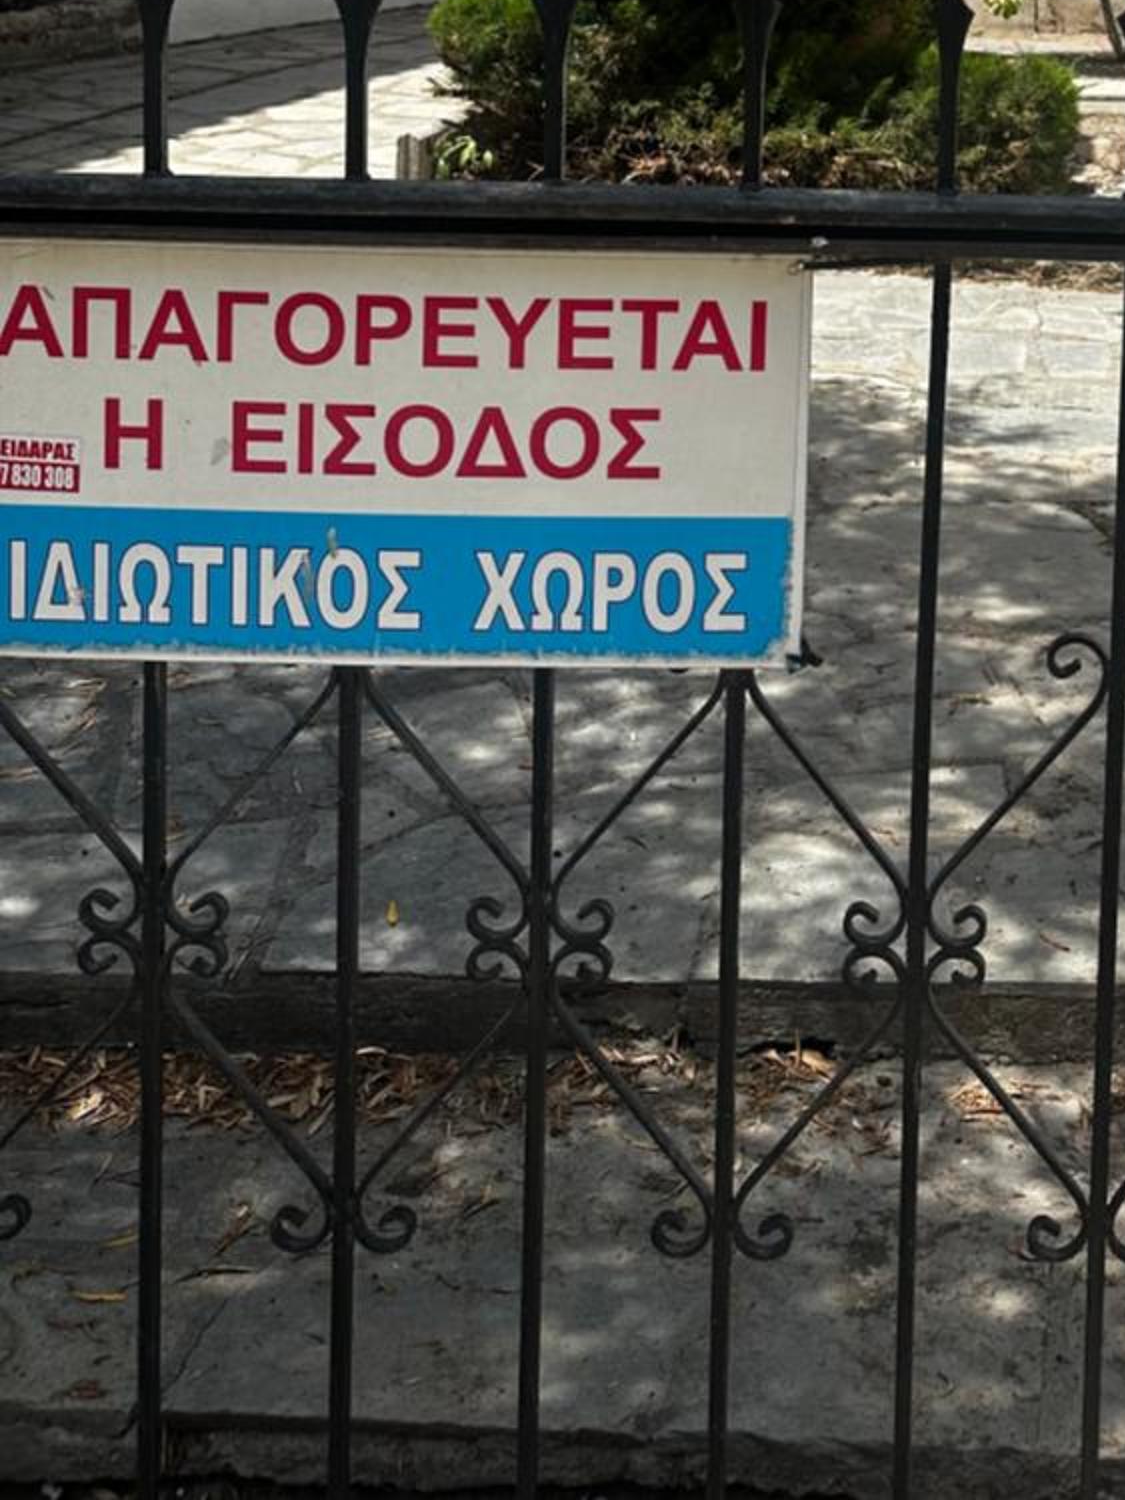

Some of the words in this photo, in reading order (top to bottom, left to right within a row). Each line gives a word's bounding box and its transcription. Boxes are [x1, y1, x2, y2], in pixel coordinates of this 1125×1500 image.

[0, 284, 769, 373] ΑΠΑΓΟΡΕΥΕΤΑΙ
[103, 397, 164, 471] Η
[230, 400, 662, 481] ΕΙΣΟΔΟΣ
[9, 539, 423, 632] ΙΔΙΩΤΙΚΟΣ
[472, 549, 750, 635] ΧΩΡΟΣ
